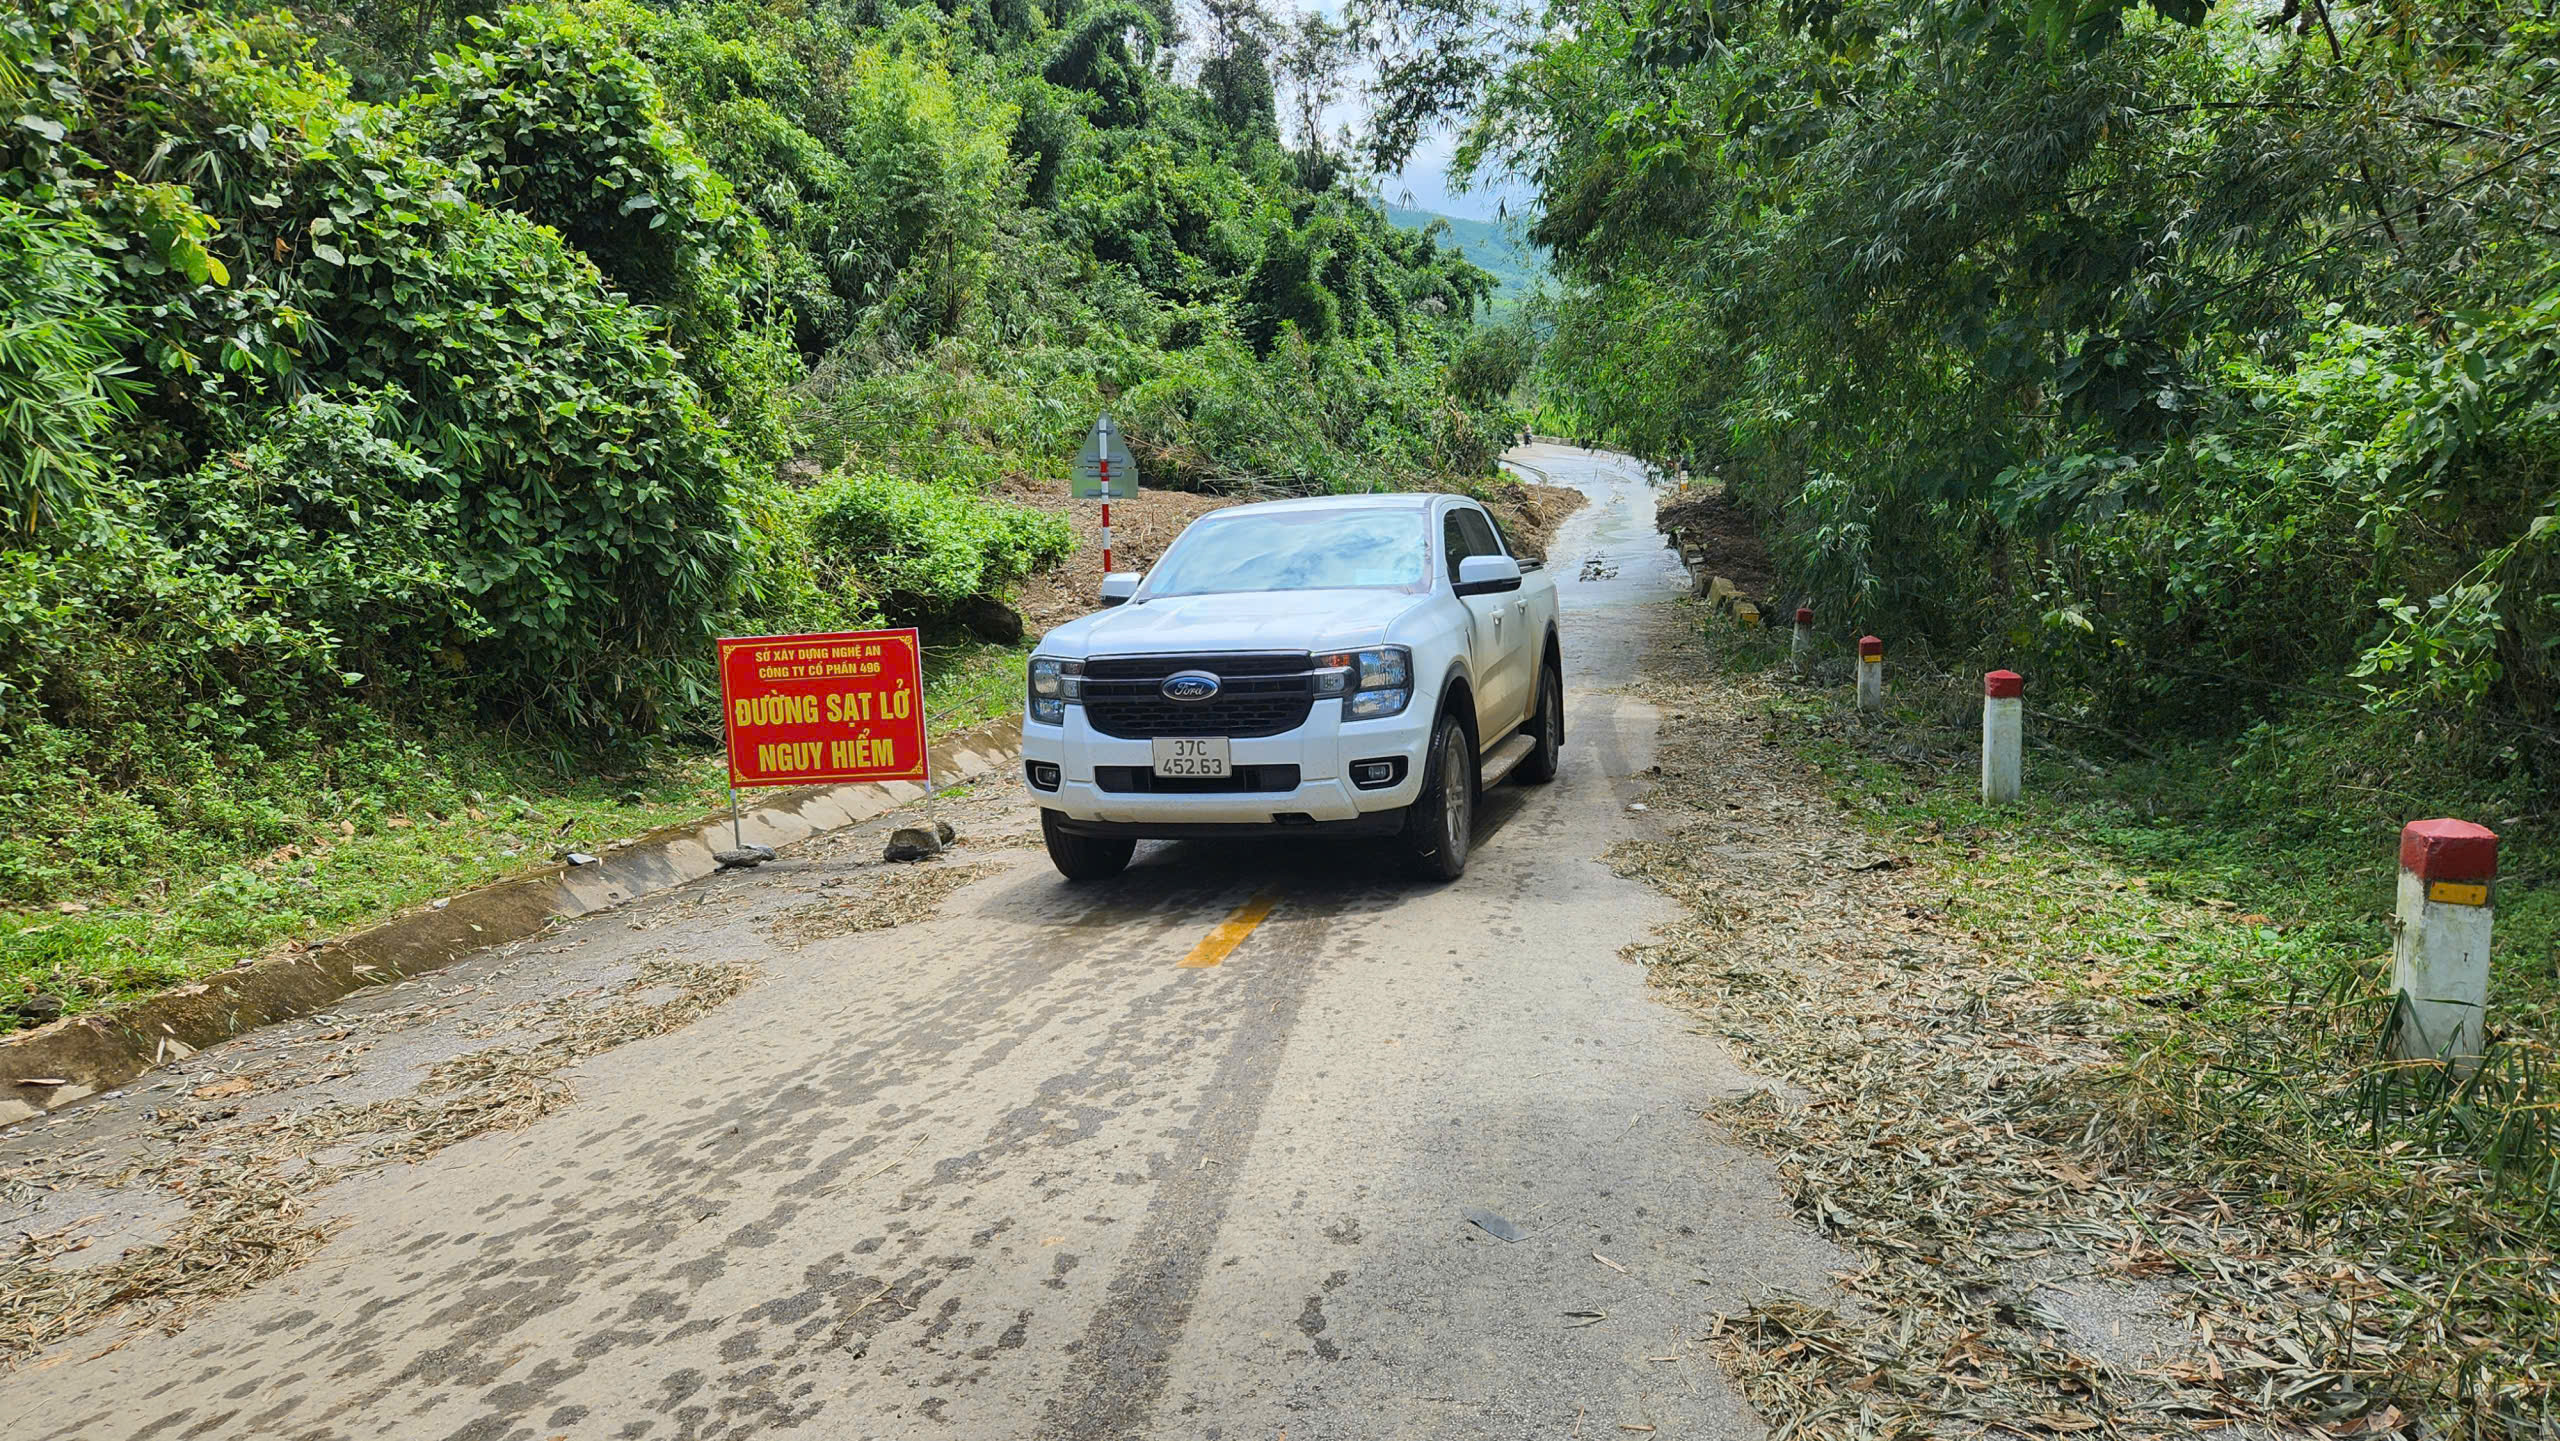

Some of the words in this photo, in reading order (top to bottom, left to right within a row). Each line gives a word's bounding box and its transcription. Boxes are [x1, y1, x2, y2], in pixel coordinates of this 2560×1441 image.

[755, 647, 771, 662] SỞ
[774, 648, 795, 661] XÂY
[798, 648, 829, 662] DỰNG
[832, 645, 861, 659] NGHỆ
[865, 645, 881, 656] AN
[759, 665, 789, 679] CÔNG
[792, 666, 805, 677] TY
[808, 660, 823, 676] CỔ
[860, 662, 881, 673] 496
[1174, 682, 1204, 695] Ford
[735, 690, 819, 726] ĐƯỜNG
[826, 693, 872, 727] SẠT
[880, 679, 910, 719] LỞ
[758, 742, 823, 772] NGUY
[831, 728, 894, 768] HIỂM
[1174, 740, 1207, 756] 37C
[1163, 758, 1222, 775] 452.63
